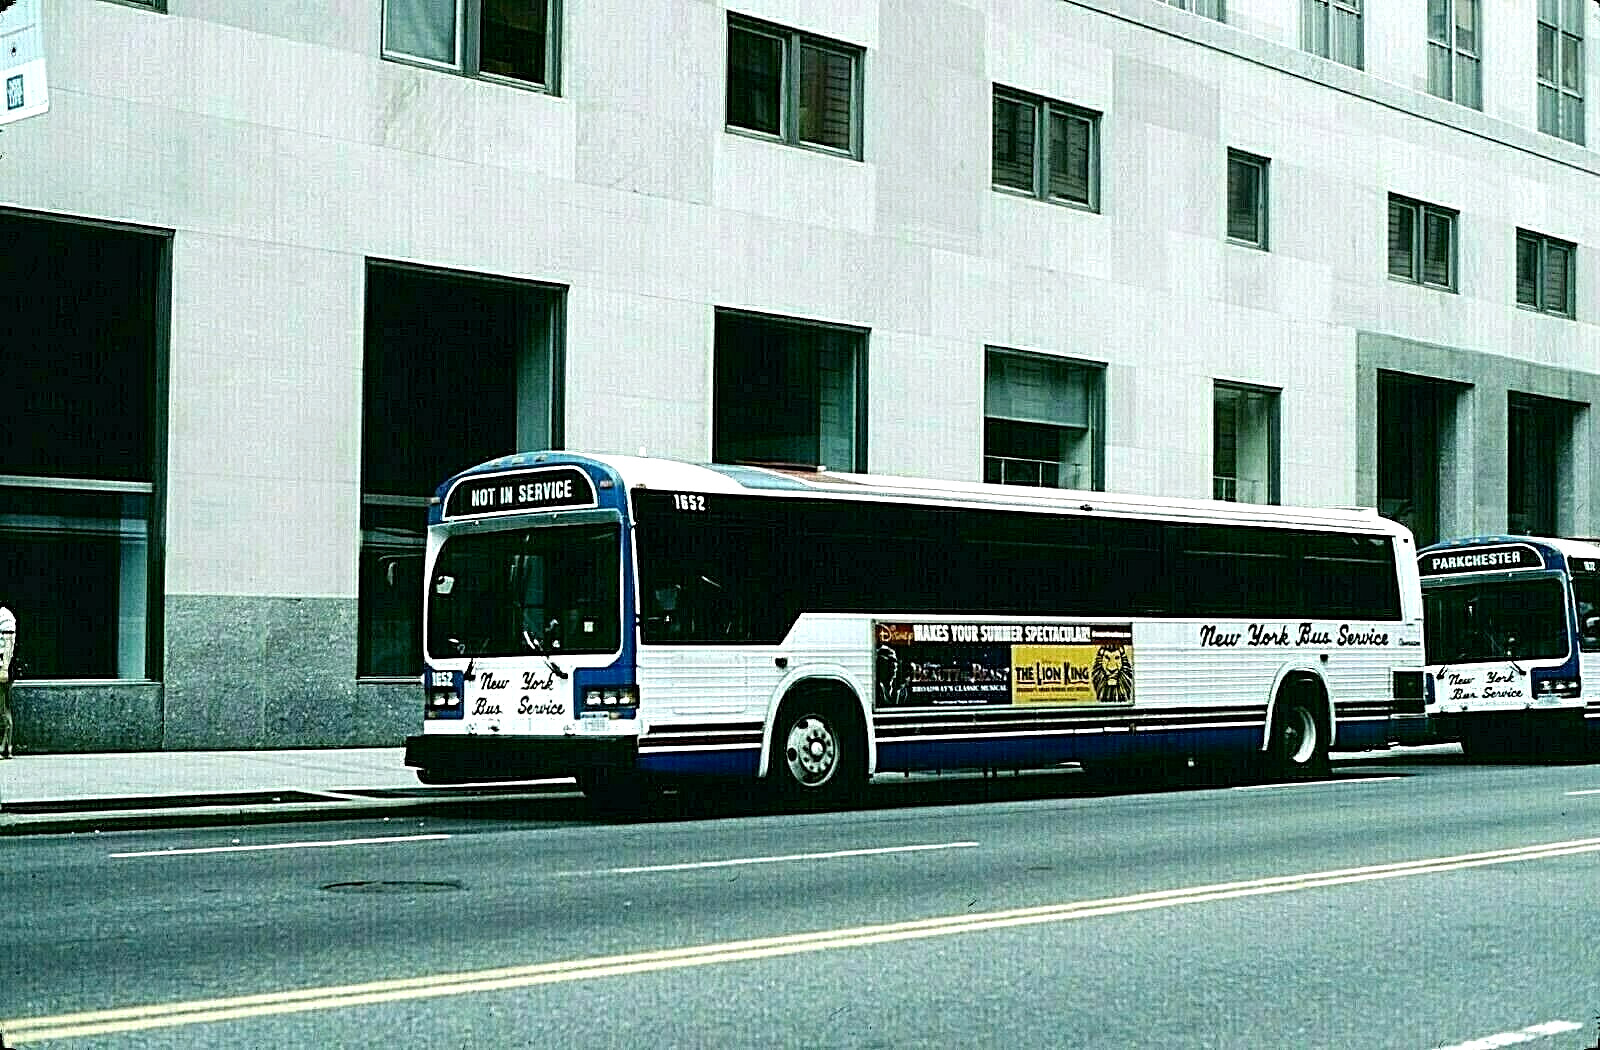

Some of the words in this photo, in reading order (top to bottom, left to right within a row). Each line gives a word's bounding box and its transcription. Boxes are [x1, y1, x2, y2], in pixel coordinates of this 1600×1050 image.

[472, 487, 496, 507] NOT
[500, 485, 513, 504] IN
[518, 479, 572, 503] SERVICE
[673, 494, 706, 511] 1652
[1432, 551, 1521, 570] PARKCHESTER
[913, 624, 949, 642] MAKES
[950, 624, 978, 642] YOUR
[980, 624, 1023, 642] SUMMER
[1200, 625, 1241, 647] New
[1248, 623, 1290, 646] York
[1296, 623, 1332, 645] Bus
[1337, 624, 1389, 646] Service
[432, 671, 453, 687] 1652
[480, 672, 510, 690] New
[520, 671, 554, 691] York
[1016, 667, 1034, 681] THE
[1036, 662, 1062, 686] LION
[1064, 662, 1089, 686] KING
[1449, 673, 1475, 686] New
[1486, 671, 1516, 684] York
[1450, 688, 1479, 700] Bus
[1482, 686, 1524, 699] Service
[472, 697, 503, 715] Bus
[517, 695, 566, 715] Service
